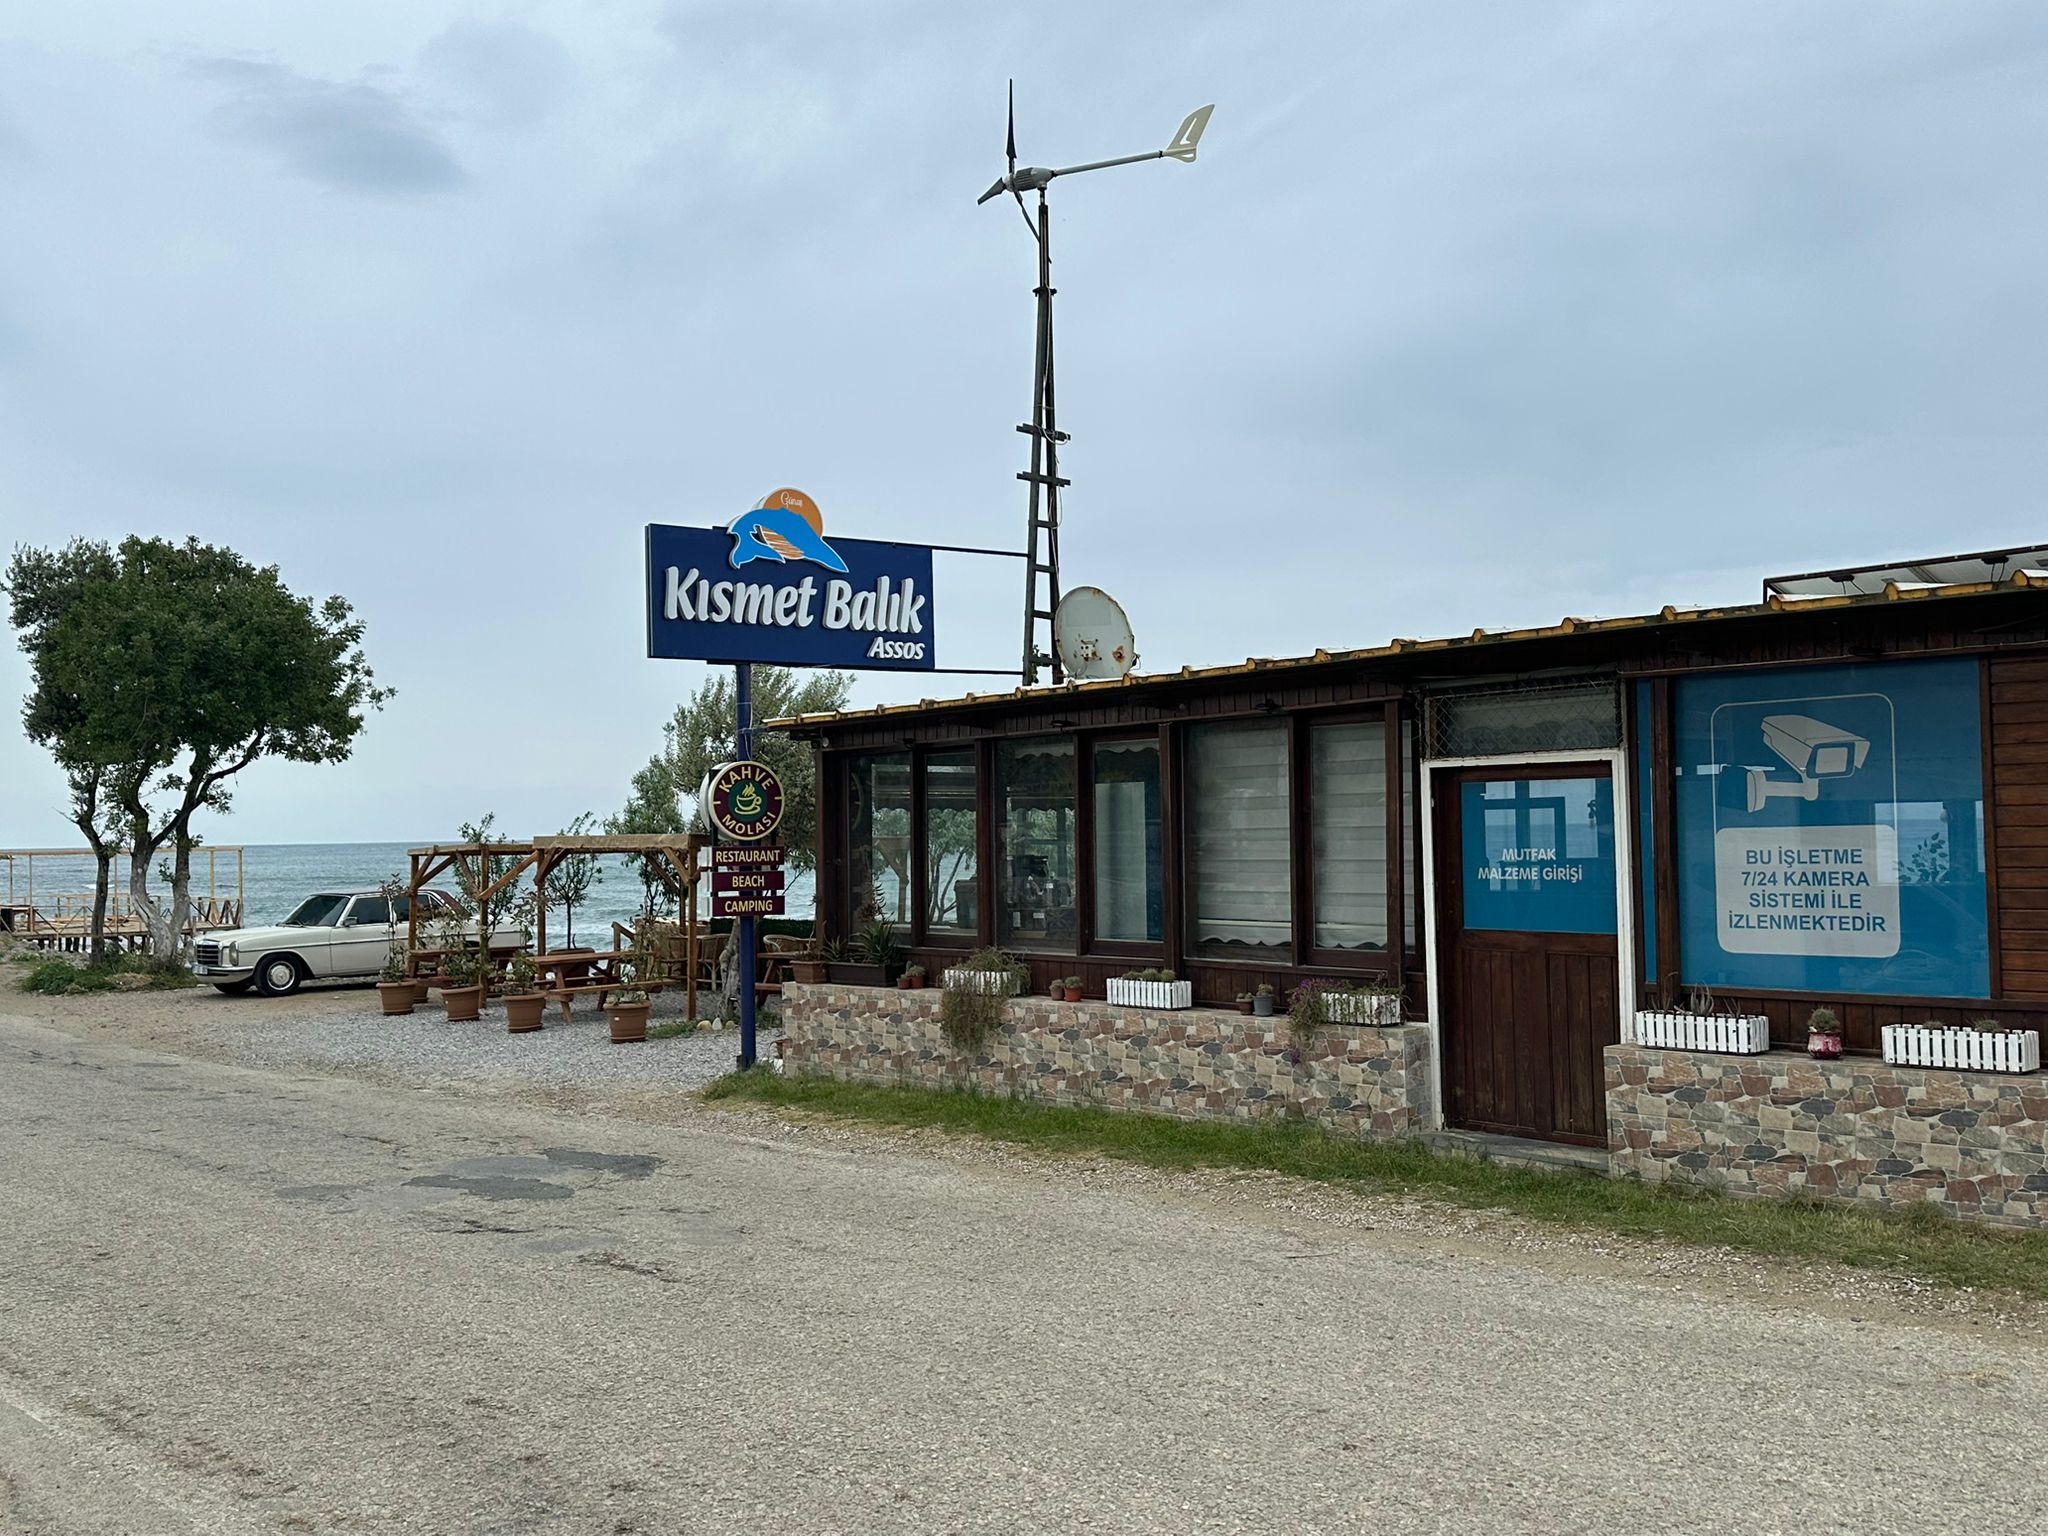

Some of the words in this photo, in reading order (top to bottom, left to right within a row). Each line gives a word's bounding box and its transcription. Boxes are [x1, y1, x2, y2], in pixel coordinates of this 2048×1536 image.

[665, 566, 817, 627] Kısmet
[823, 575, 925, 634] Balık
[867, 636, 925, 660] Assos
[718, 766, 774, 793] KAHVE
[722, 811, 776, 835] MOLASI
[716, 850, 780, 863] RESTAURANT
[1502, 848, 1557, 861] MUTFAK
[1746, 850, 1771, 865] BU
[1778, 846, 1863, 868] İŞLETME
[732, 875, 765, 888] BEACH
[1478, 867, 1539, 880] MALZEME
[1542, 864, 1583, 883] GİRİŞİ
[1741, 871, 1778, 887] 7/24
[1784, 871, 1870, 887] KAMERA
[725, 900, 773, 912] CAMPING
[1749, 889, 1825, 909] SİSTEMİ
[1831, 889, 1862, 909] İLE
[1728, 910, 1886, 932] İZLENMEKTEDİR
